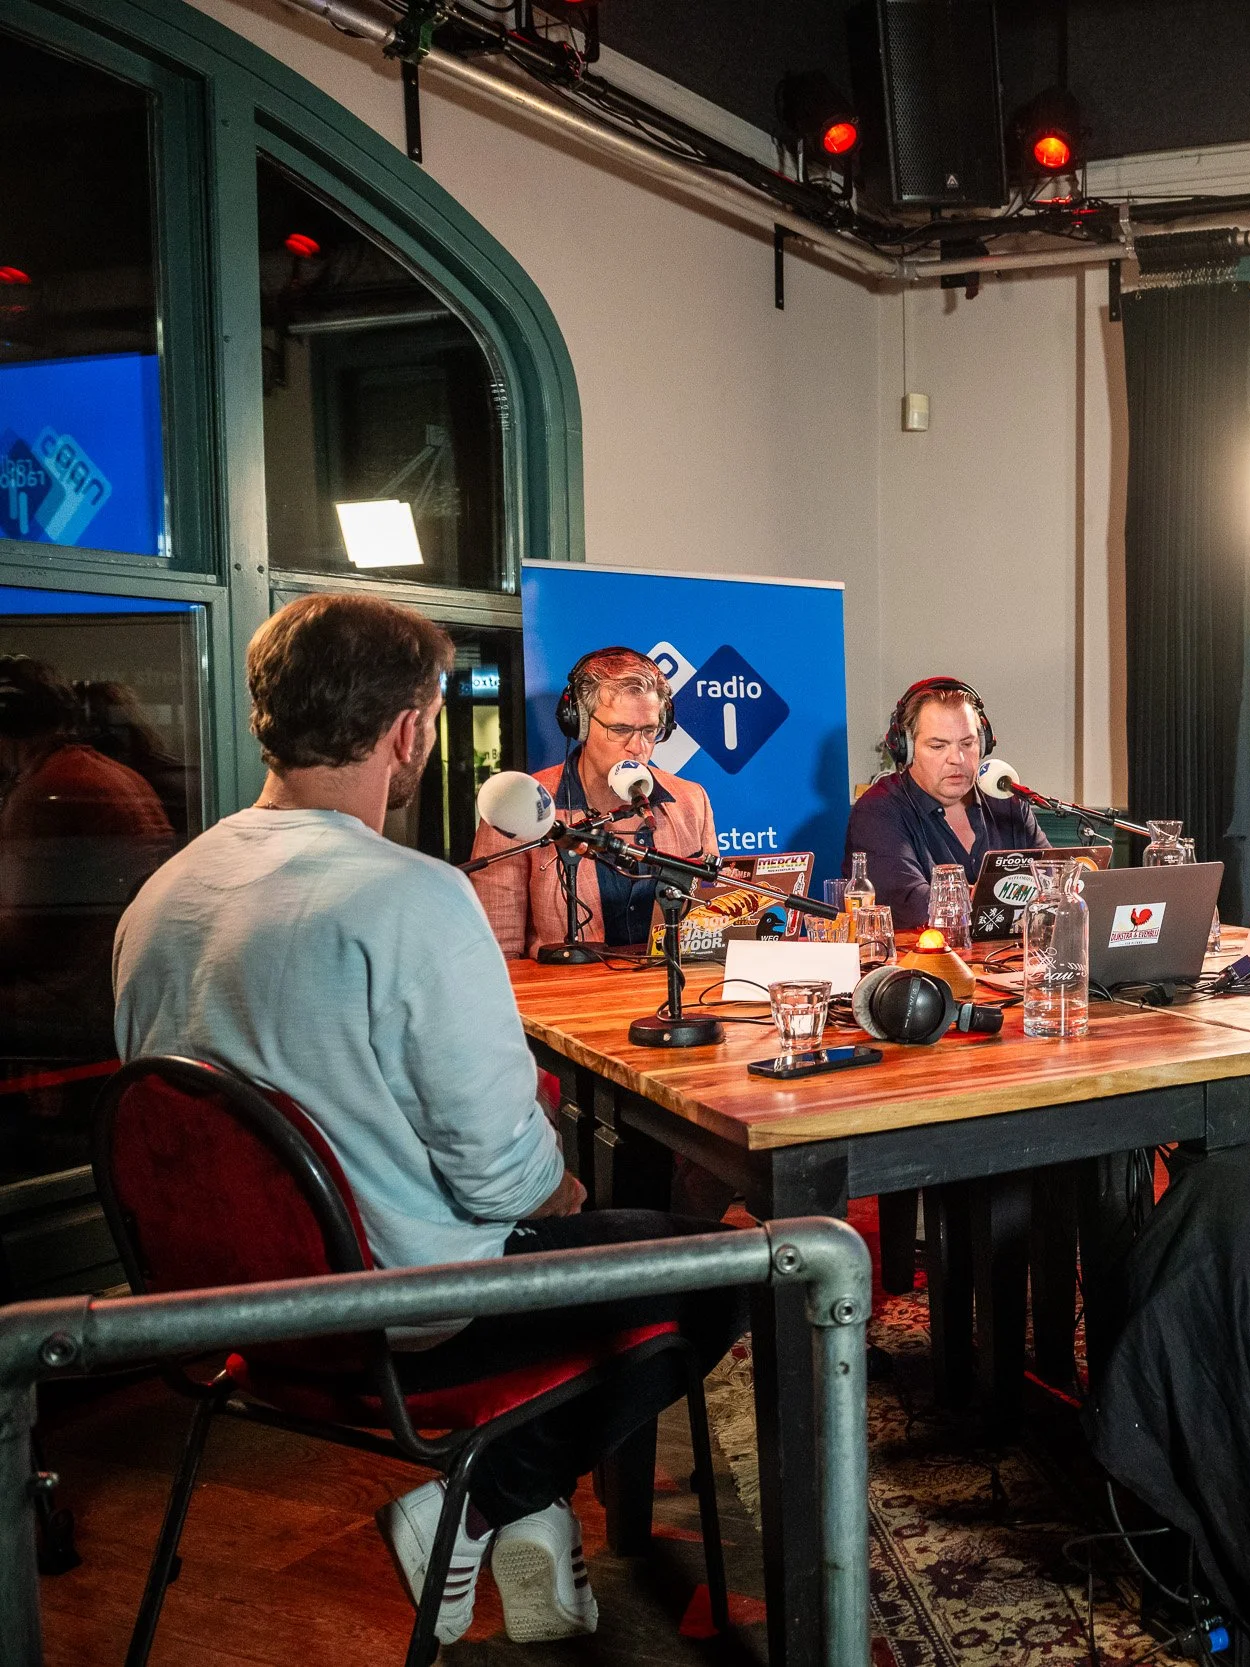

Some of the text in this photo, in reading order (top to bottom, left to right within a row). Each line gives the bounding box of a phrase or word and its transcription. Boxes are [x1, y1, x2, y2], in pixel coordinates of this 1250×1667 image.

[696, 675, 762, 699] radio
[718, 826, 778, 850] stert
[995, 857, 1034, 867] groove
[998, 881, 1038, 903] MIAMI
[680, 937, 726, 952] VOOR.
[683, 930, 723, 941] JAAR
